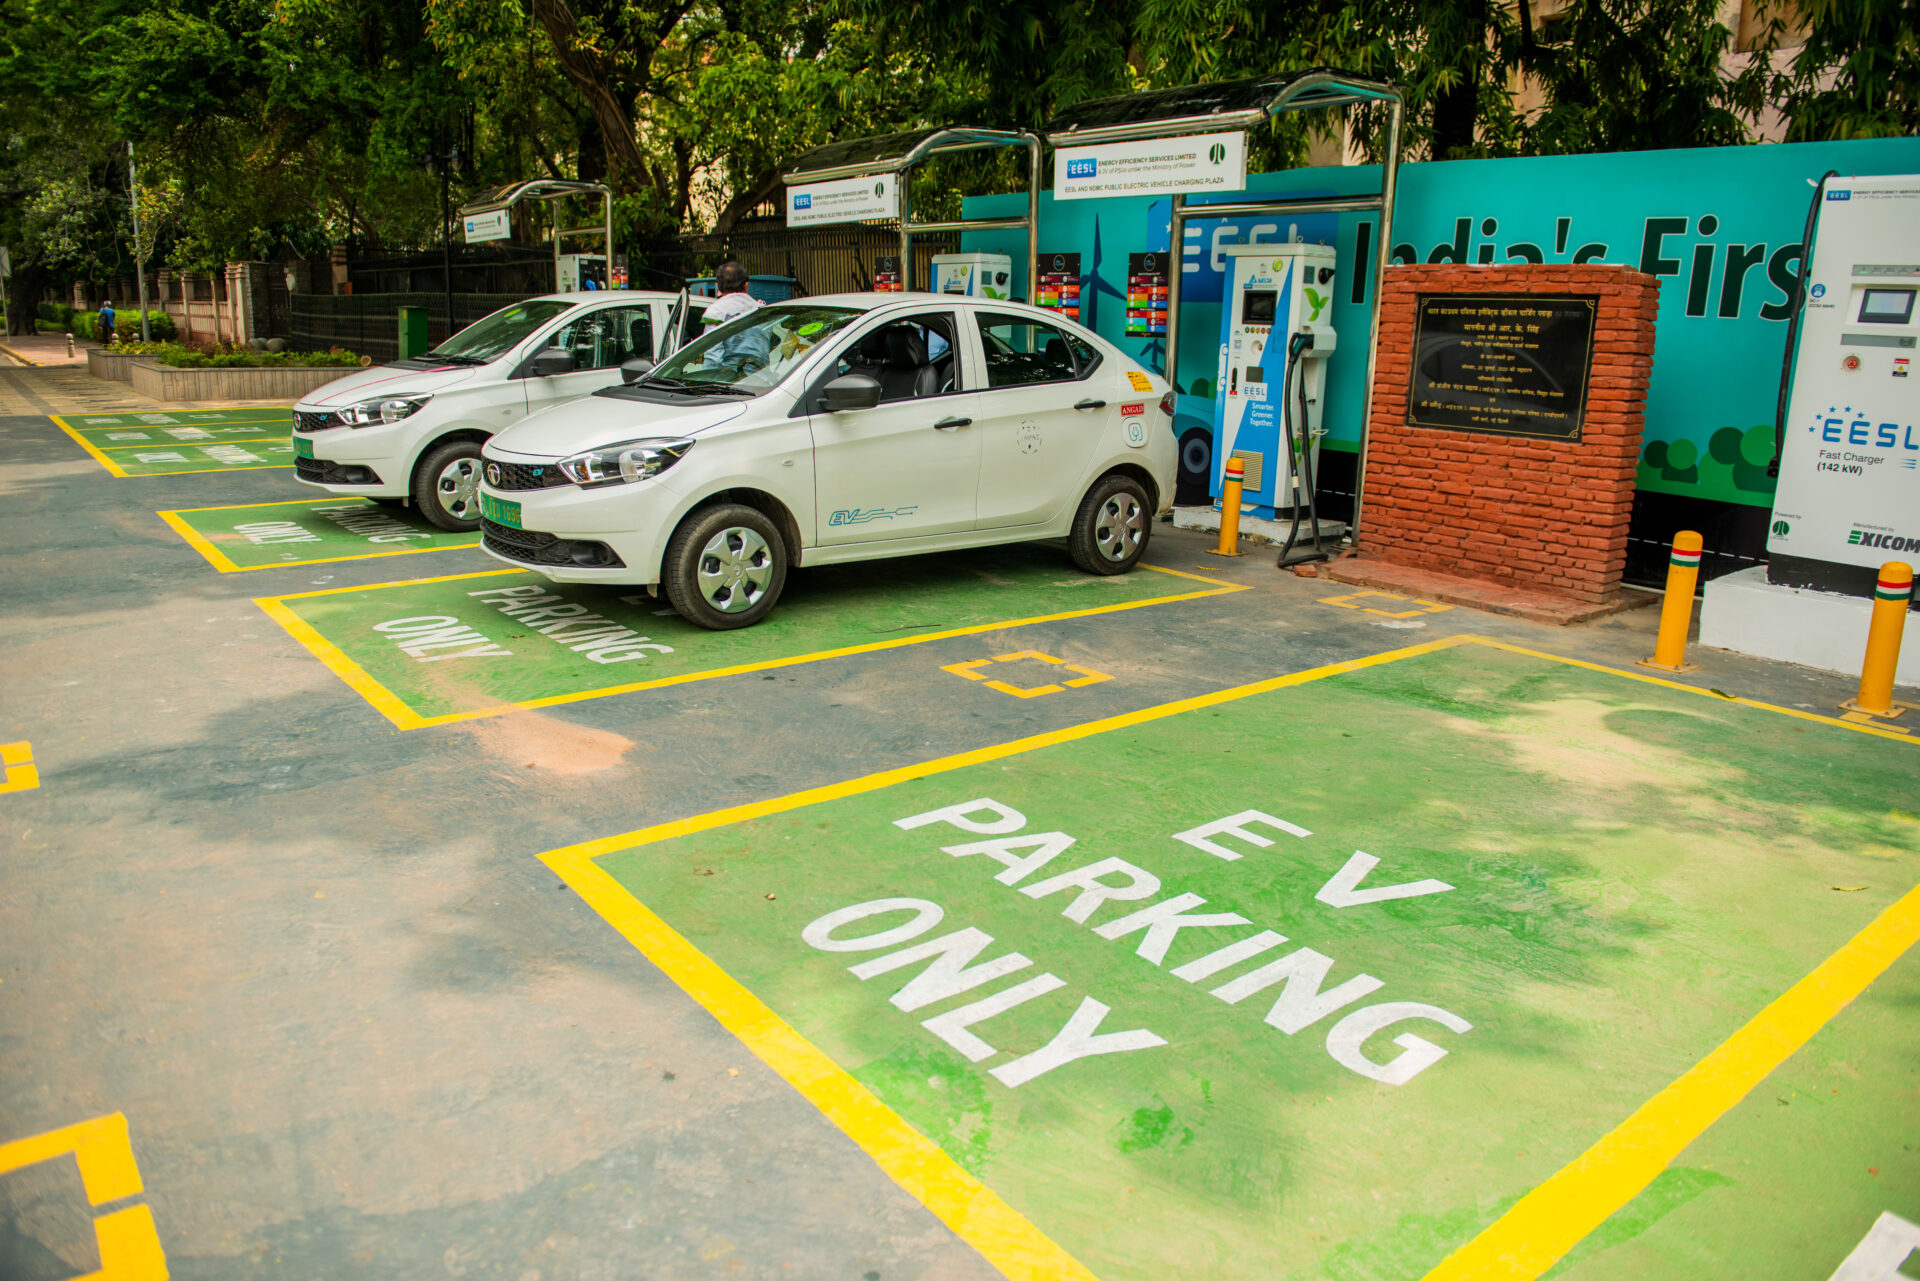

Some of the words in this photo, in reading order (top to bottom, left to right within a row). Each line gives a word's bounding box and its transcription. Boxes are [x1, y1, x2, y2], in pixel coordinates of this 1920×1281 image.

[1098, 159, 1118, 167] ENERGY
[1119, 157, 1148, 166] EFFICIENCY
[1149, 155, 1174, 164] SERVICES
[1174, 153, 1197, 161] LIMITED
[1071, 161, 1095, 175] EESL
[1123, 182, 1150, 190] ELECTRIC
[1150, 180, 1173, 188] VEHICLE
[1174, 178, 1205, 187] CHARGING
[1205, 177, 1225, 185] PLAZA
[1244, 386, 1265, 396] EESL
[1122, 404, 1144, 414] ANGAD
[1252, 402, 1275, 411] Smarter.
[1252, 410, 1274, 419] Greener.
[1250, 418, 1273, 427] Together.
[1822, 418, 1919, 451] EESL
[1819, 450, 1841, 460] Fast
[1843, 452, 1884, 465] Charger
[532, 467, 544, 477] EV
[1817, 462, 1839, 473] (142
[1842, 464, 1863, 476] kW)
[829, 508, 861, 526] EV
[1848, 529, 1920, 554] EXICOM
[467, 584, 675, 664] PARKING
[372, 615, 514, 663] ONLY
[891, 797, 1474, 1086] PARKING
[801, 897, 1168, 1089] ONLY
